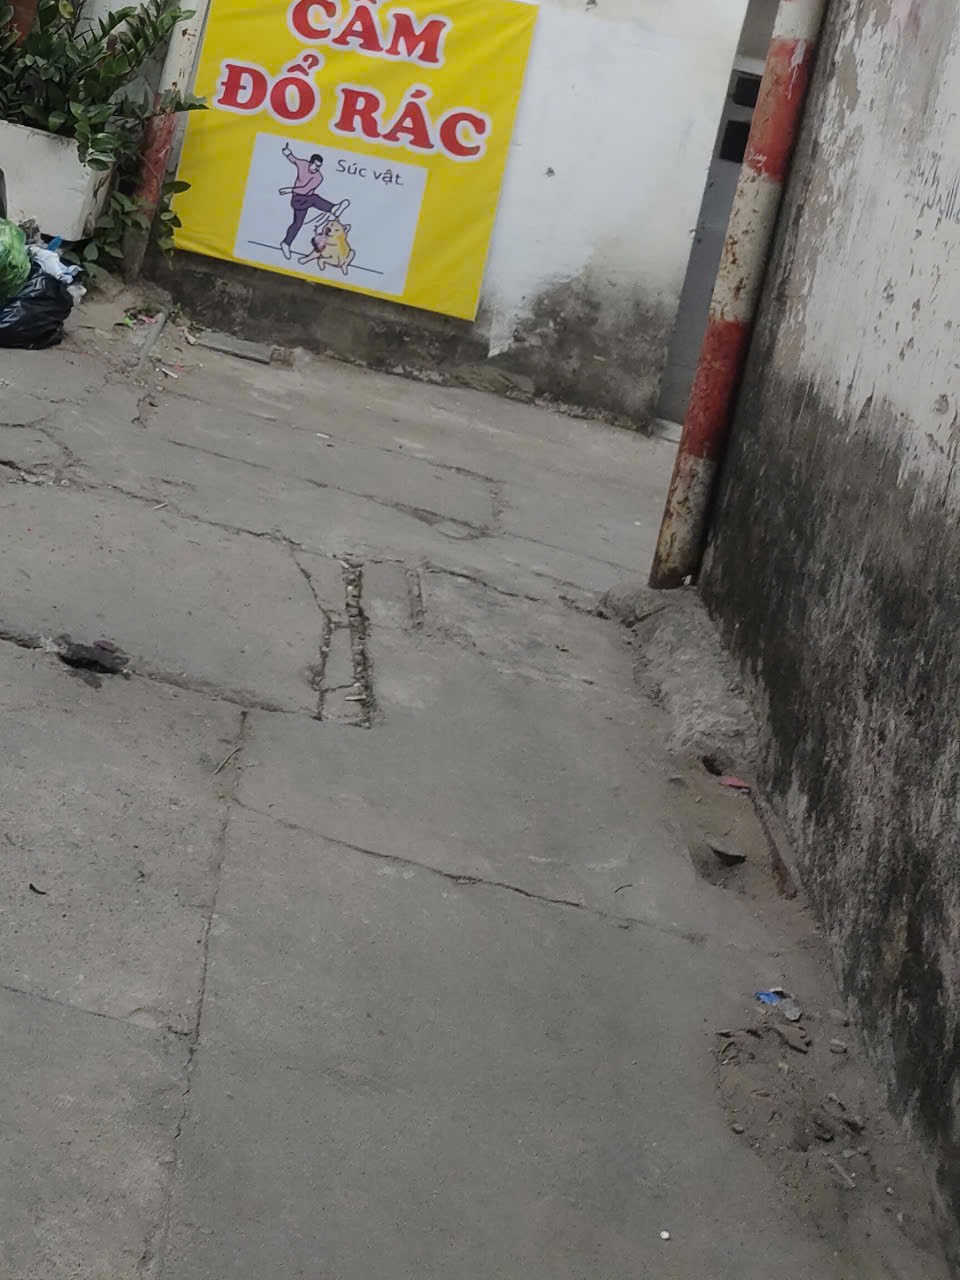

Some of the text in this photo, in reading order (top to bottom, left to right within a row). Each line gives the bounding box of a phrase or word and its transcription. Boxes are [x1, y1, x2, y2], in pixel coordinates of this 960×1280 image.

[216, 54, 487, 158] ĐỔ RÁC
[336, 159, 405, 187] Súc vật
